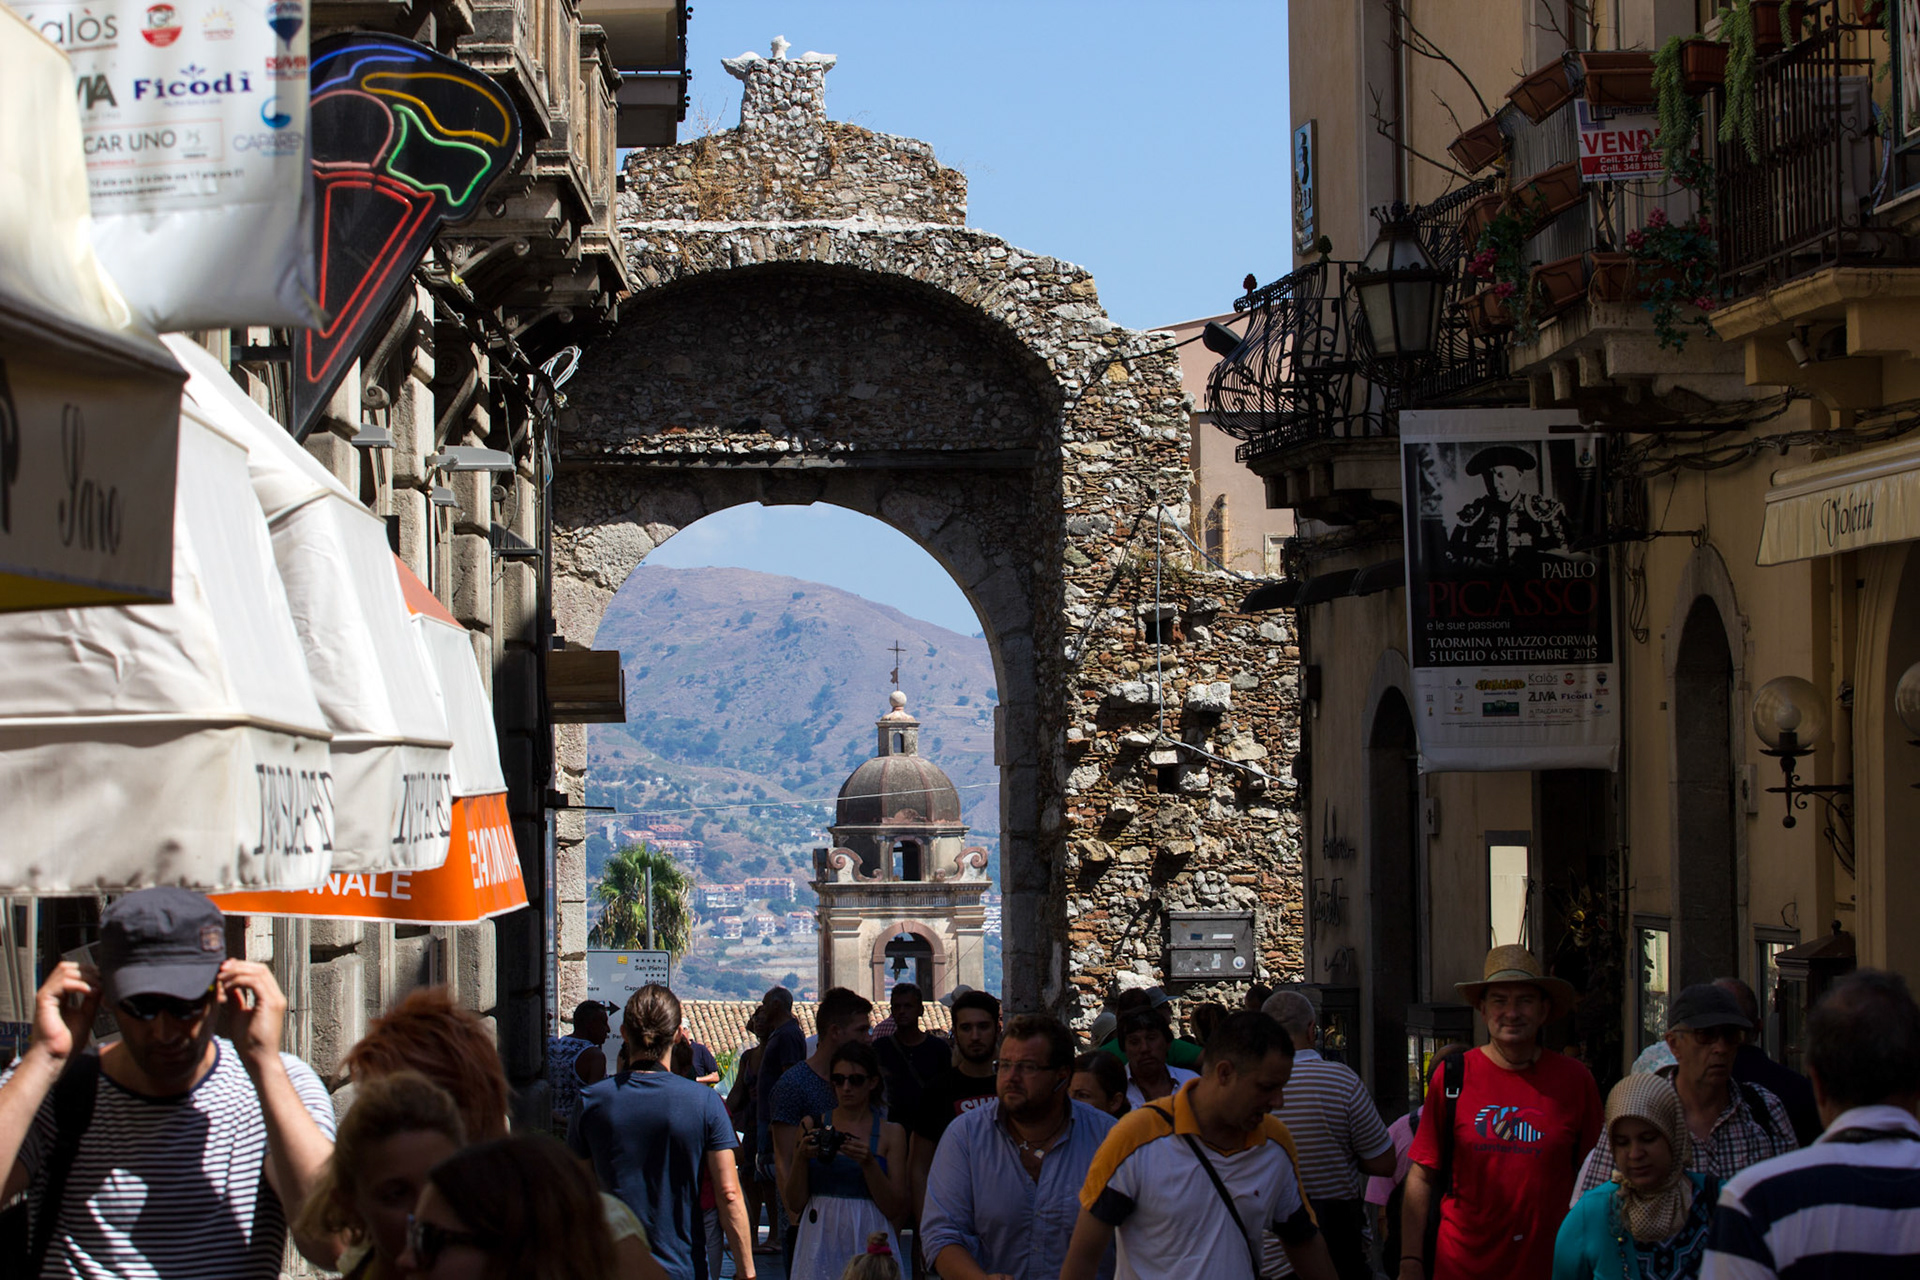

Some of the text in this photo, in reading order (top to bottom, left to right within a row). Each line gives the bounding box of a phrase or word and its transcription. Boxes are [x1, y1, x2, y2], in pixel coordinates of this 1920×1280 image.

[40, 8, 118, 44] alòs
[133, 70, 253, 100] Ficodi
[84, 130, 176, 155] CAR UNO
[1623, 154, 1639, 163] 347
[1820, 493, 1874, 548] Violetta
[1541, 561, 1597, 579] PABLO
[1426, 578, 1599, 618] PICASSO
[1426, 623, 1433, 631] e
[1435, 620, 1445, 631] le
[1446, 622, 1466, 631] sue
[1467, 619, 1511, 632] passioni
[1427, 634, 1598, 649] TAORMINA PALAZZO CORVAJA
[1428, 648, 1598, 663] 5 LUGLIO 6 SETTEMBRE 2015
[1561, 692, 1593, 700] Ficodi
[316, 871, 413, 901] NALE
